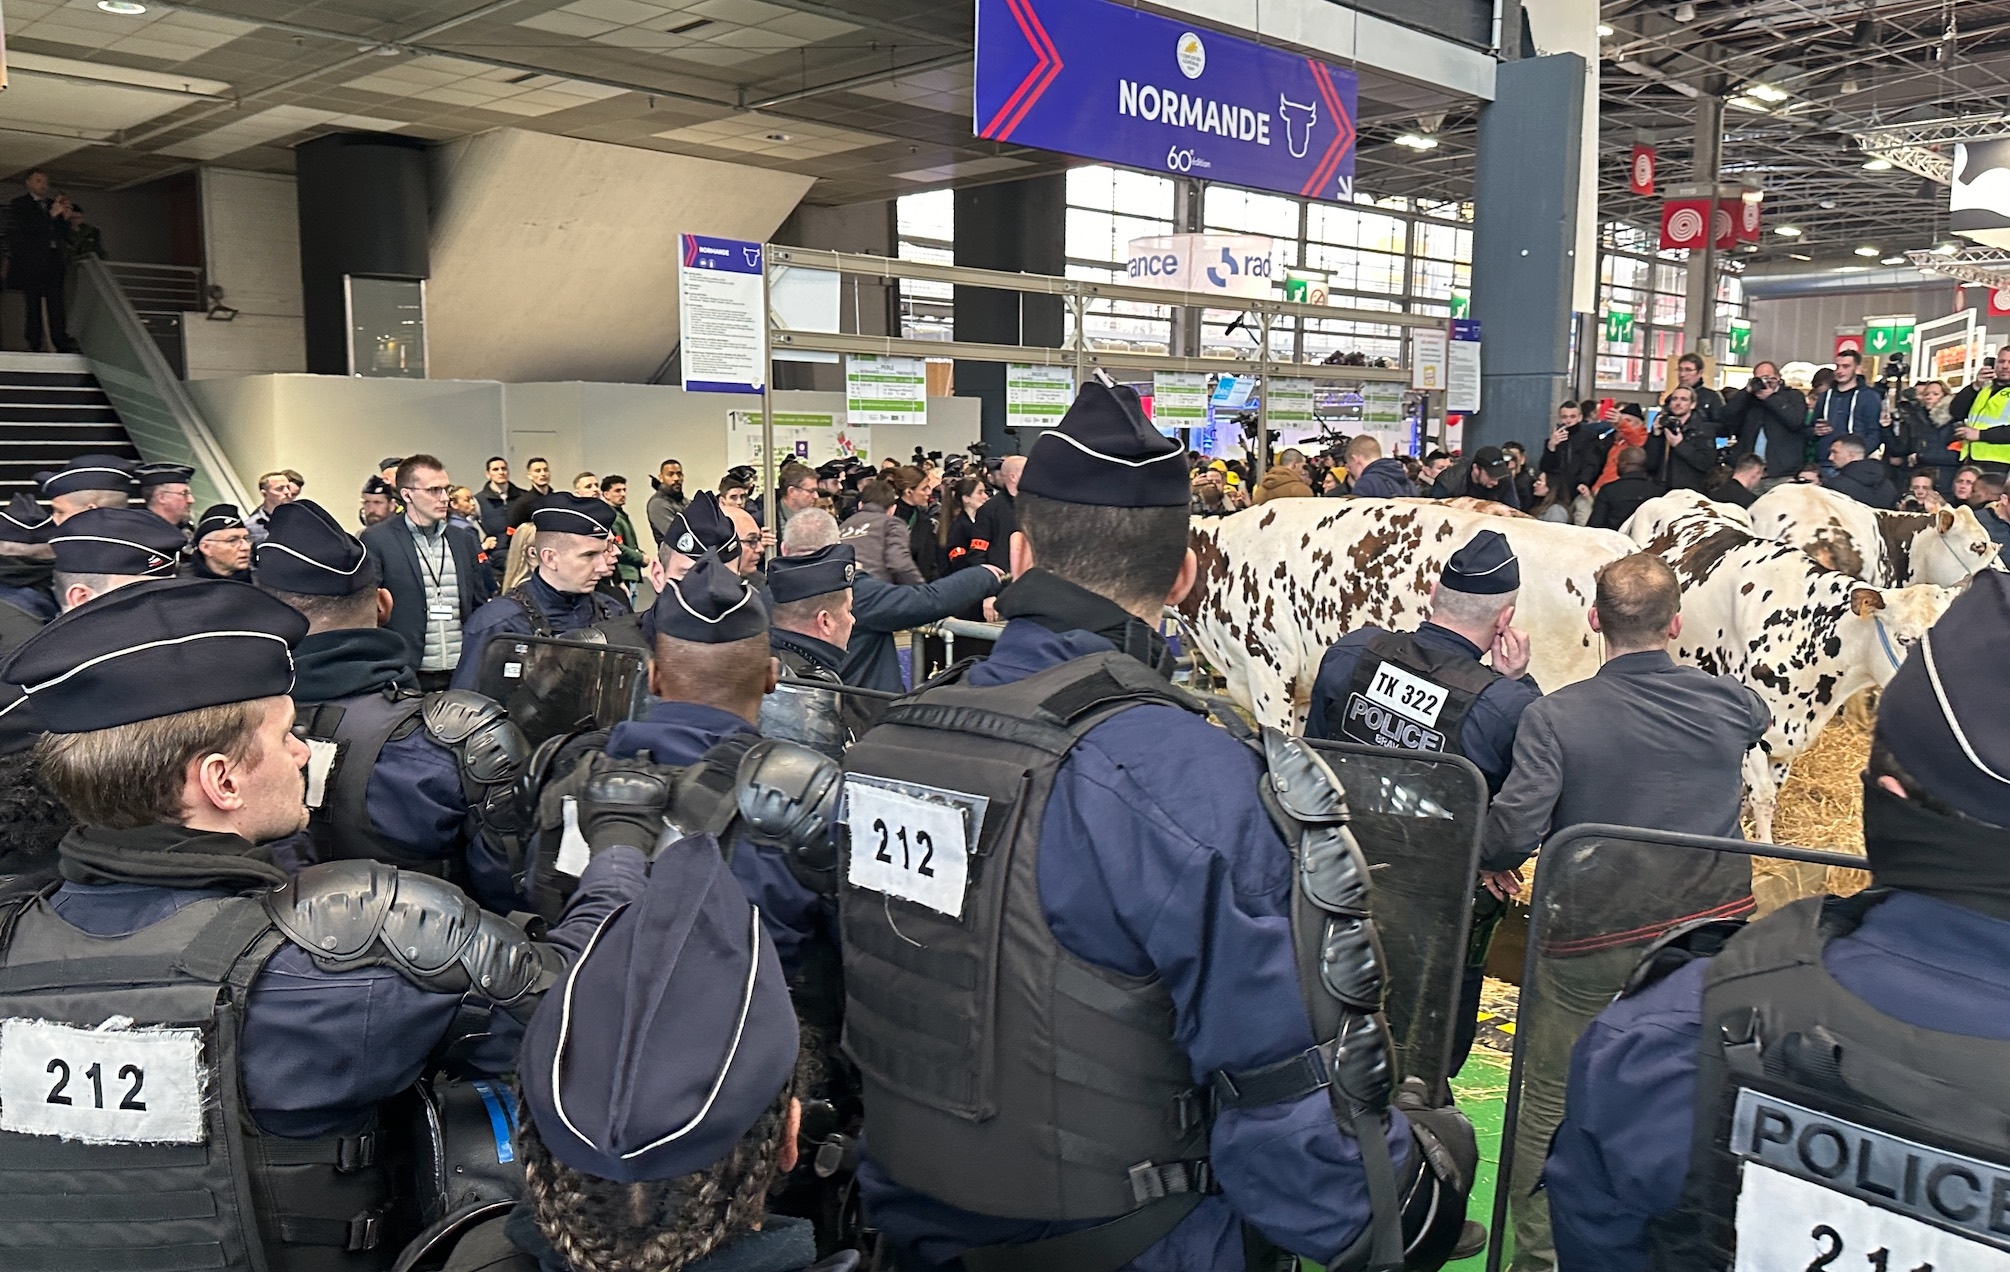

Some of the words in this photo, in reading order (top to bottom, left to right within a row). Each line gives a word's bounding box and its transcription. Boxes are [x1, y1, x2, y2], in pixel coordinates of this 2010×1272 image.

[1119, 79, 1271, 146] NORMANDE
[729, 411, 736, 431] 1
[1375, 672, 1400, 698] TK
[1401, 684, 1438, 716] 322
[1349, 699, 1440, 752] POLICE
[873, 818, 935, 878] 212
[46, 1058, 147, 1111] 212
